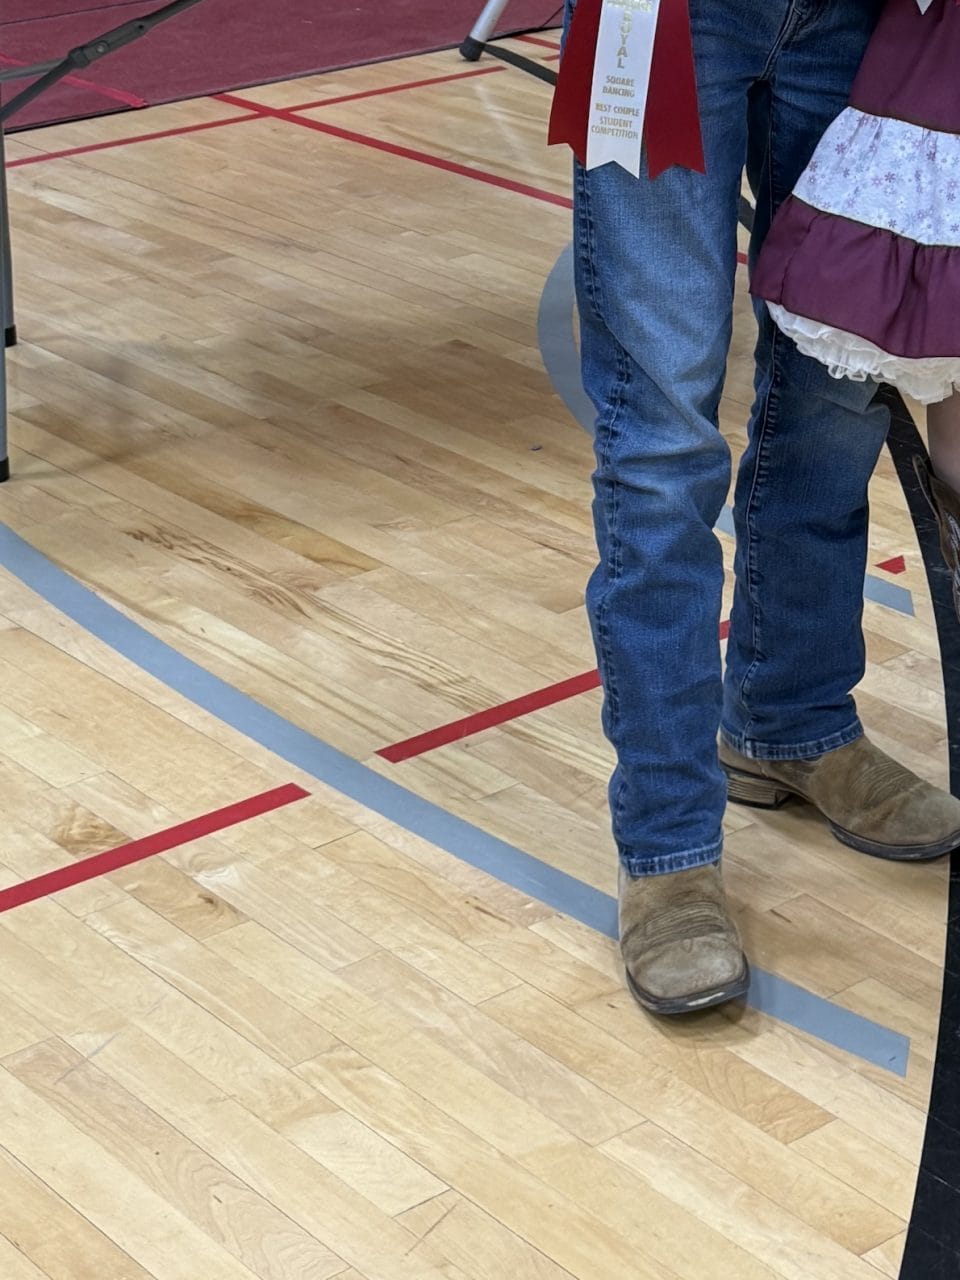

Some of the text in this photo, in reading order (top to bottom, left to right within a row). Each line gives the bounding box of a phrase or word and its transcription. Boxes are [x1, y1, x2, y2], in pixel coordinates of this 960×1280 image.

[606, 75, 635, 87] SQUARE
[602, 86, 636, 98] DANCING
[595, 102, 640, 117] BEST COUPLE
[600, 116, 633, 129] STUDENT
[591, 124, 639, 140] COMPETITION
